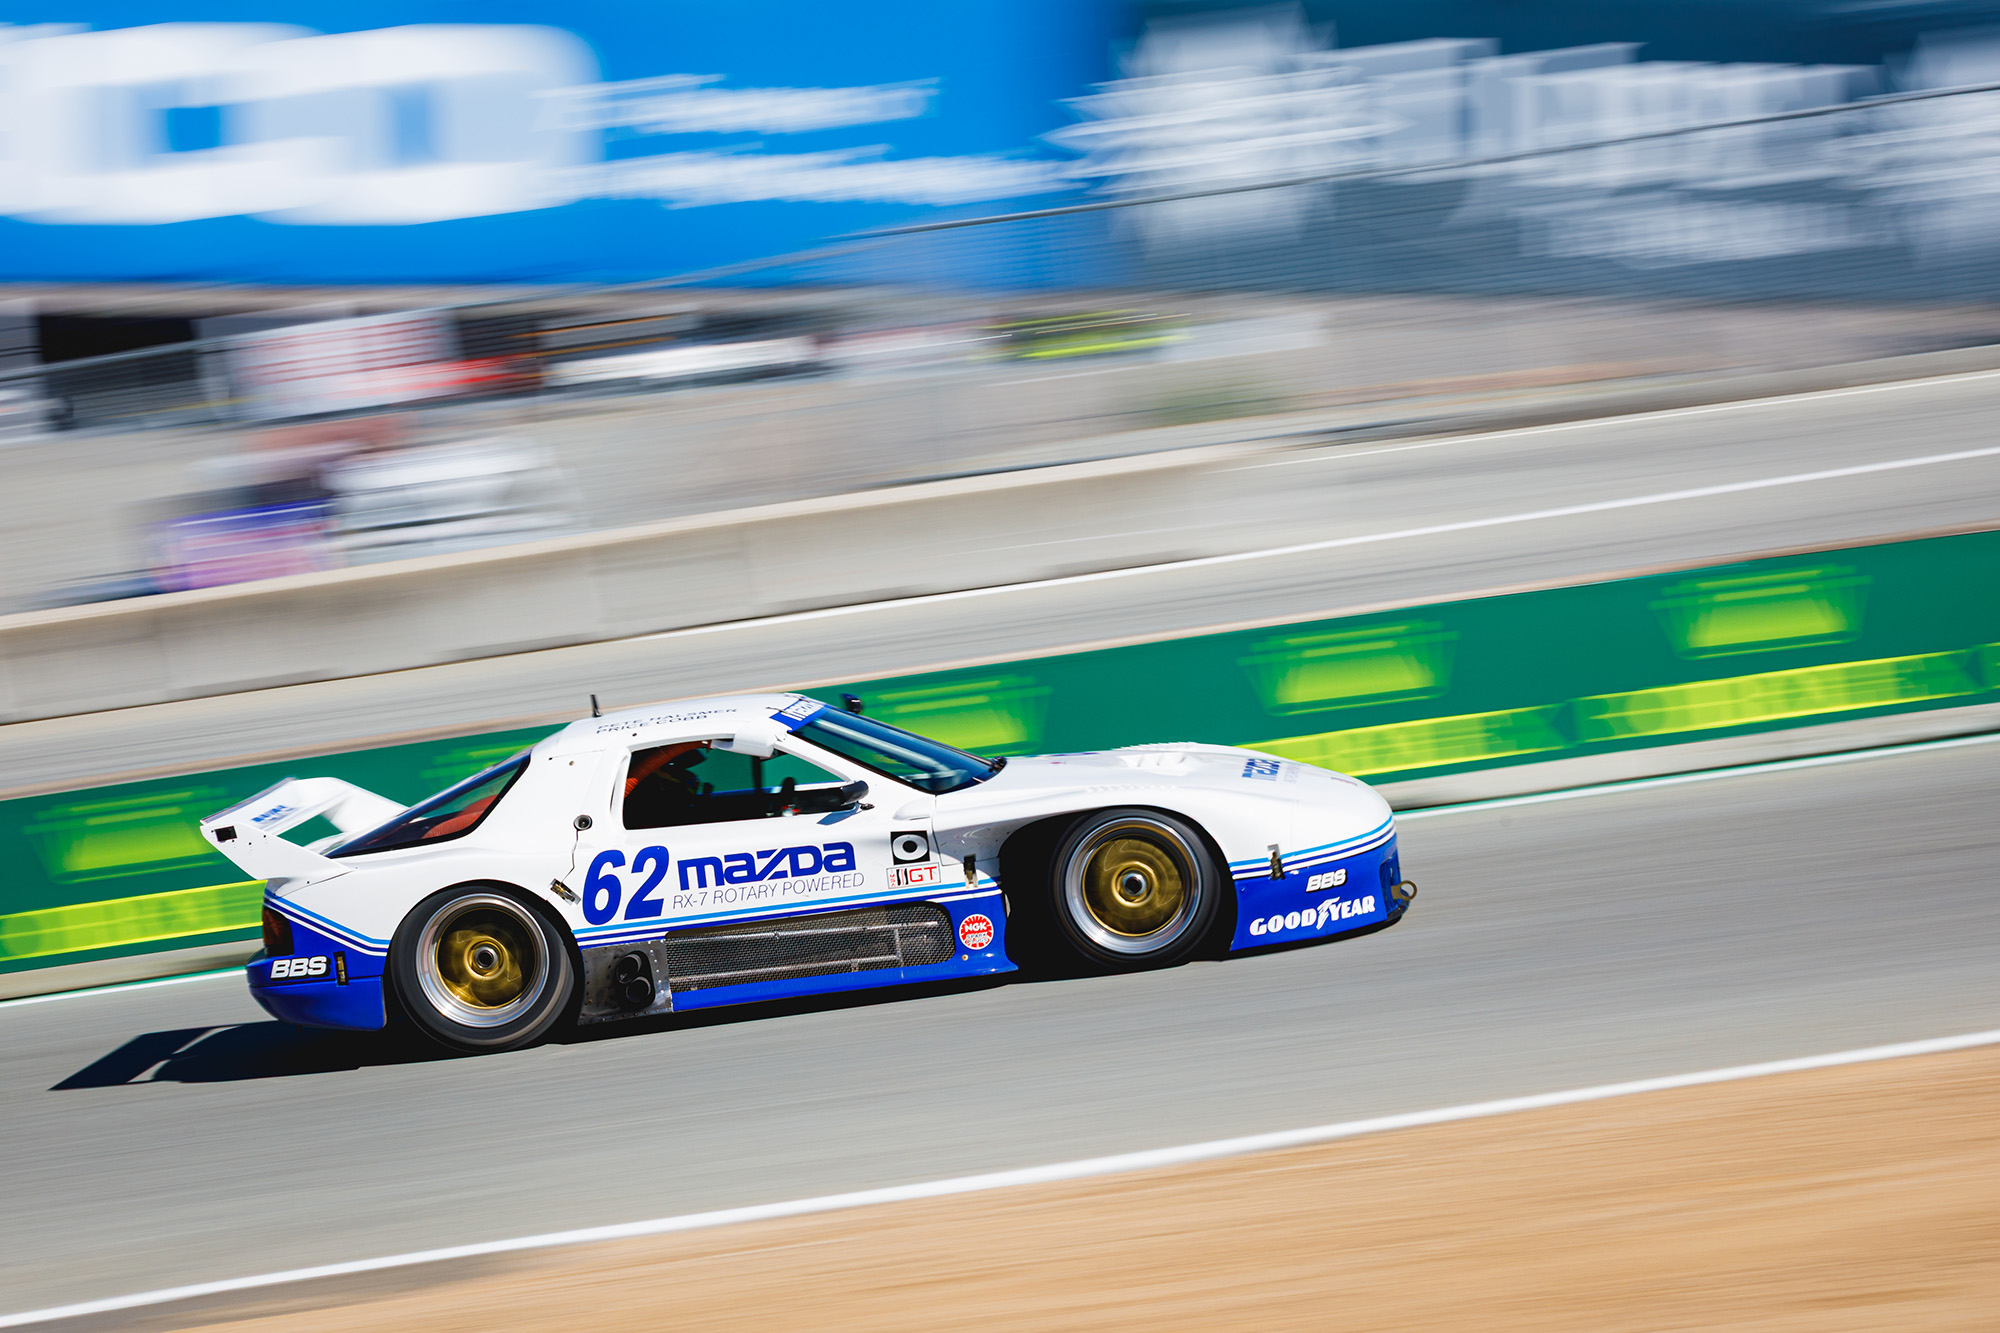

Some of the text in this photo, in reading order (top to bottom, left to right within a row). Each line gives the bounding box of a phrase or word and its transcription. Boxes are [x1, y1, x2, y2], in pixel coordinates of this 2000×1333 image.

[582, 845, 669, 925] 62
[909, 866, 938, 883] GT
[1305, 868, 1347, 893] BBS
[672, 872, 865, 910] RX-7 ROTARY POWERED
[964, 922, 987, 932] NGK
[1249, 895, 1376, 936] GOODYEAR
[270, 955, 329, 980] BBS
